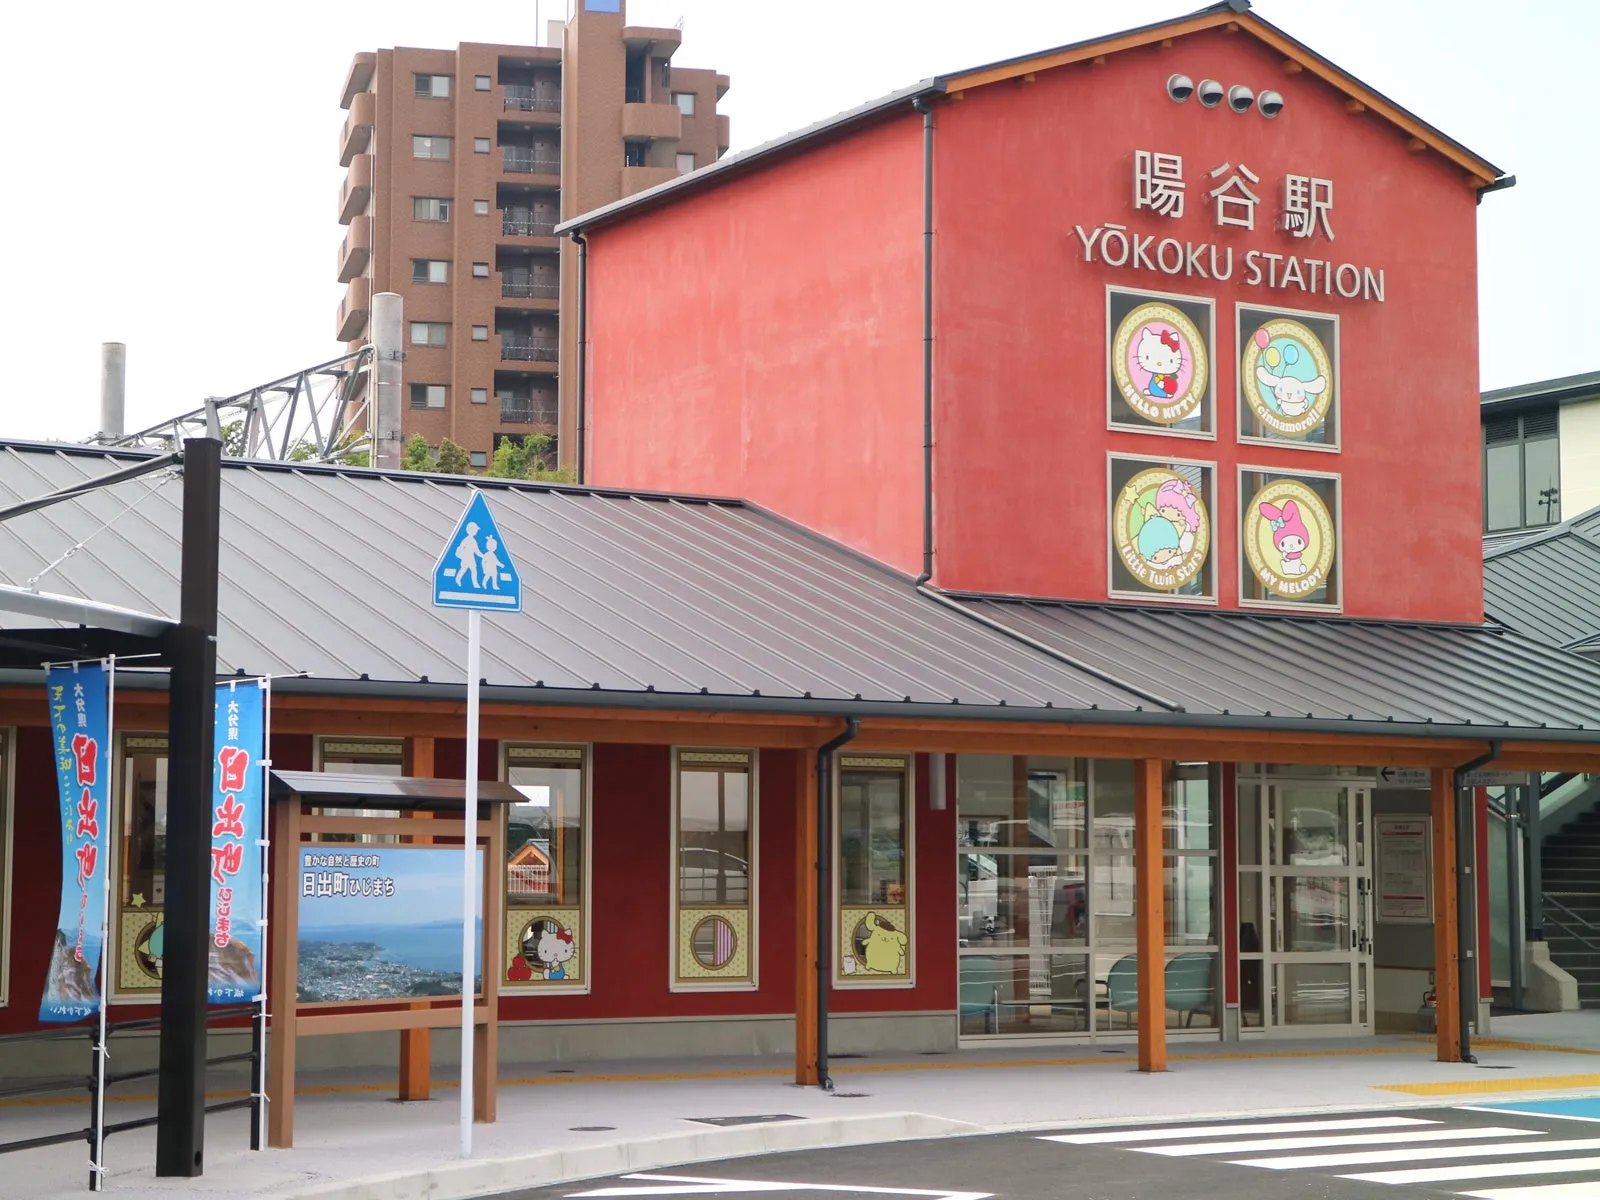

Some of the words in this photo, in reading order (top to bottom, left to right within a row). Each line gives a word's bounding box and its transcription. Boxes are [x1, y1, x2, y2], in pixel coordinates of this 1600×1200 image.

[1132, 149, 1335, 241] 暘谷駅
[1074, 222, 1233, 281] YŌKOKU
[1246, 250, 1385, 302] STATION
[1123, 384, 1159, 417] HELLO
[1163, 392, 1196, 419] KITTY
[1257, 405, 1320, 432] cinnamoroll
[1122, 545, 1147, 578] Little
[1148, 569, 1176, 586] Twin
[1176, 551, 1202, 581] Stars
[1260, 567, 1277, 586] MY
[1278, 568, 1322, 594] MELODY
[303, 854, 380, 868] 豊かな自然と歴史の町
[303, 872, 395, 897] 日出町ひじまち
